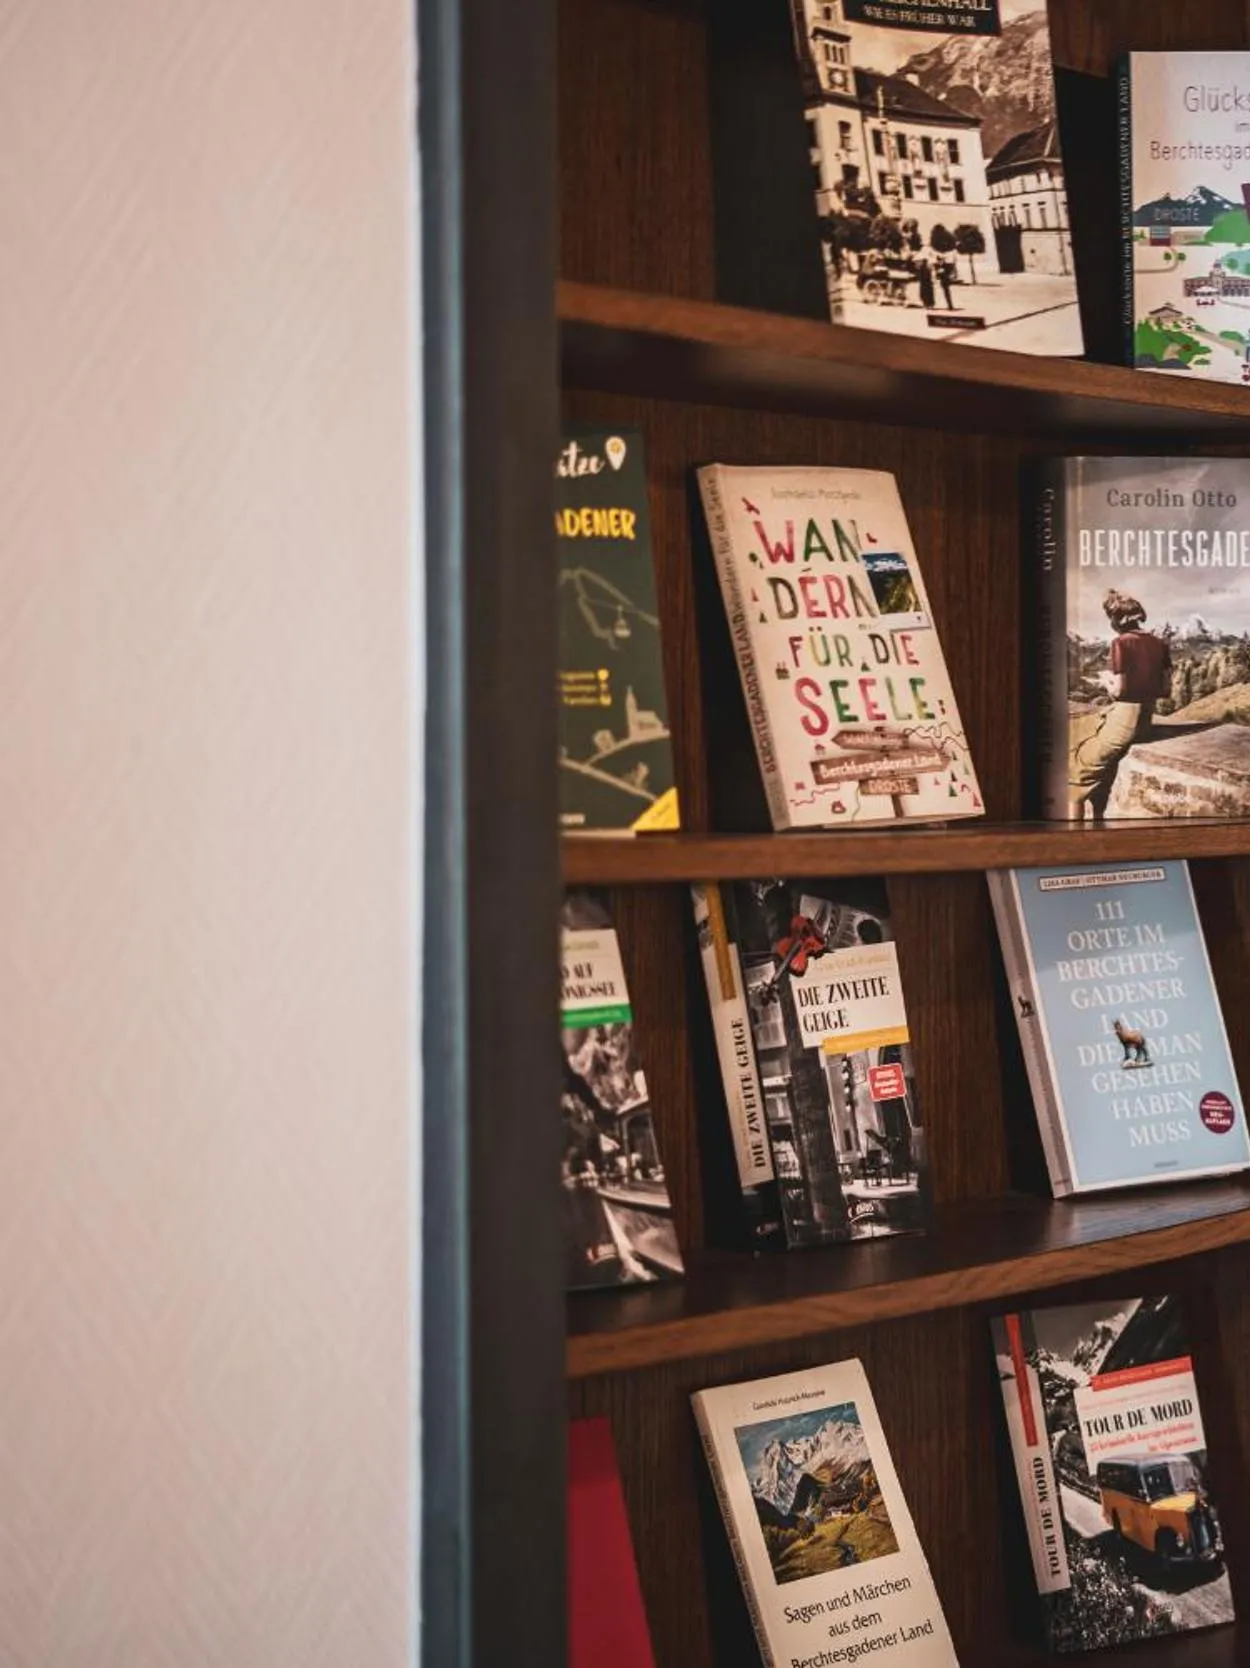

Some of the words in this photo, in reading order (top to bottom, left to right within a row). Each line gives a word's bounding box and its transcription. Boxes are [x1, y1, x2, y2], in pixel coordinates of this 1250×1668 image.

[1235, 121, 1250, 133] im
[1107, 487, 1185, 508] Carolin
[1192, 489, 1237, 508] Otto
[753, 518, 863, 564] WAN
[767, 574, 881, 620] DERN
[789, 627, 854, 669] FÜR
[868, 633, 921, 667] DIE
[794, 677, 936, 738] SEELE
[1067, 927, 1128, 952] ORTE
[1134, 923, 1165, 946] IM
[1055, 950, 1185, 982] BERCHTES-
[797, 986, 824, 1007] DIE
[826, 975, 890, 1004] ZWEITE
[1070, 978, 1188, 1010] GADENER
[803, 1008, 849, 1033] GEIGE
[1101, 1008, 1169, 1036] LAND
[732, 1018, 749, 1068] GEIGE
[1077, 1043, 1119, 1067] DIE
[1149, 1031, 1204, 1058] MAN
[1091, 1061, 1202, 1094] GESEHEN
[741, 1072, 761, 1135] ZWEITE
[1111, 1092, 1195, 1121] HABEN
[1128, 1119, 1191, 1148] MUSS
[752, 1138, 766, 1168] DIE
[1083, 1414, 1125, 1437] TOUR
[1127, 1408, 1148, 1428] DE
[1150, 1399, 1193, 1421] MORD
[1033, 1457, 1049, 1503] MORD
[1040, 1507, 1054, 1530] DE
[1045, 1535, 1061, 1578] TOUR
[784, 1602, 826, 1624] Sagen
[827, 1591, 851, 1612] und
[853, 1576, 911, 1604] Märchen
[828, 1621, 850, 1638] aus
[852, 1611, 883, 1631] dem
[791, 1632, 898, 1668] Berchtesgadener
[900, 1619, 934, 1643] Land
